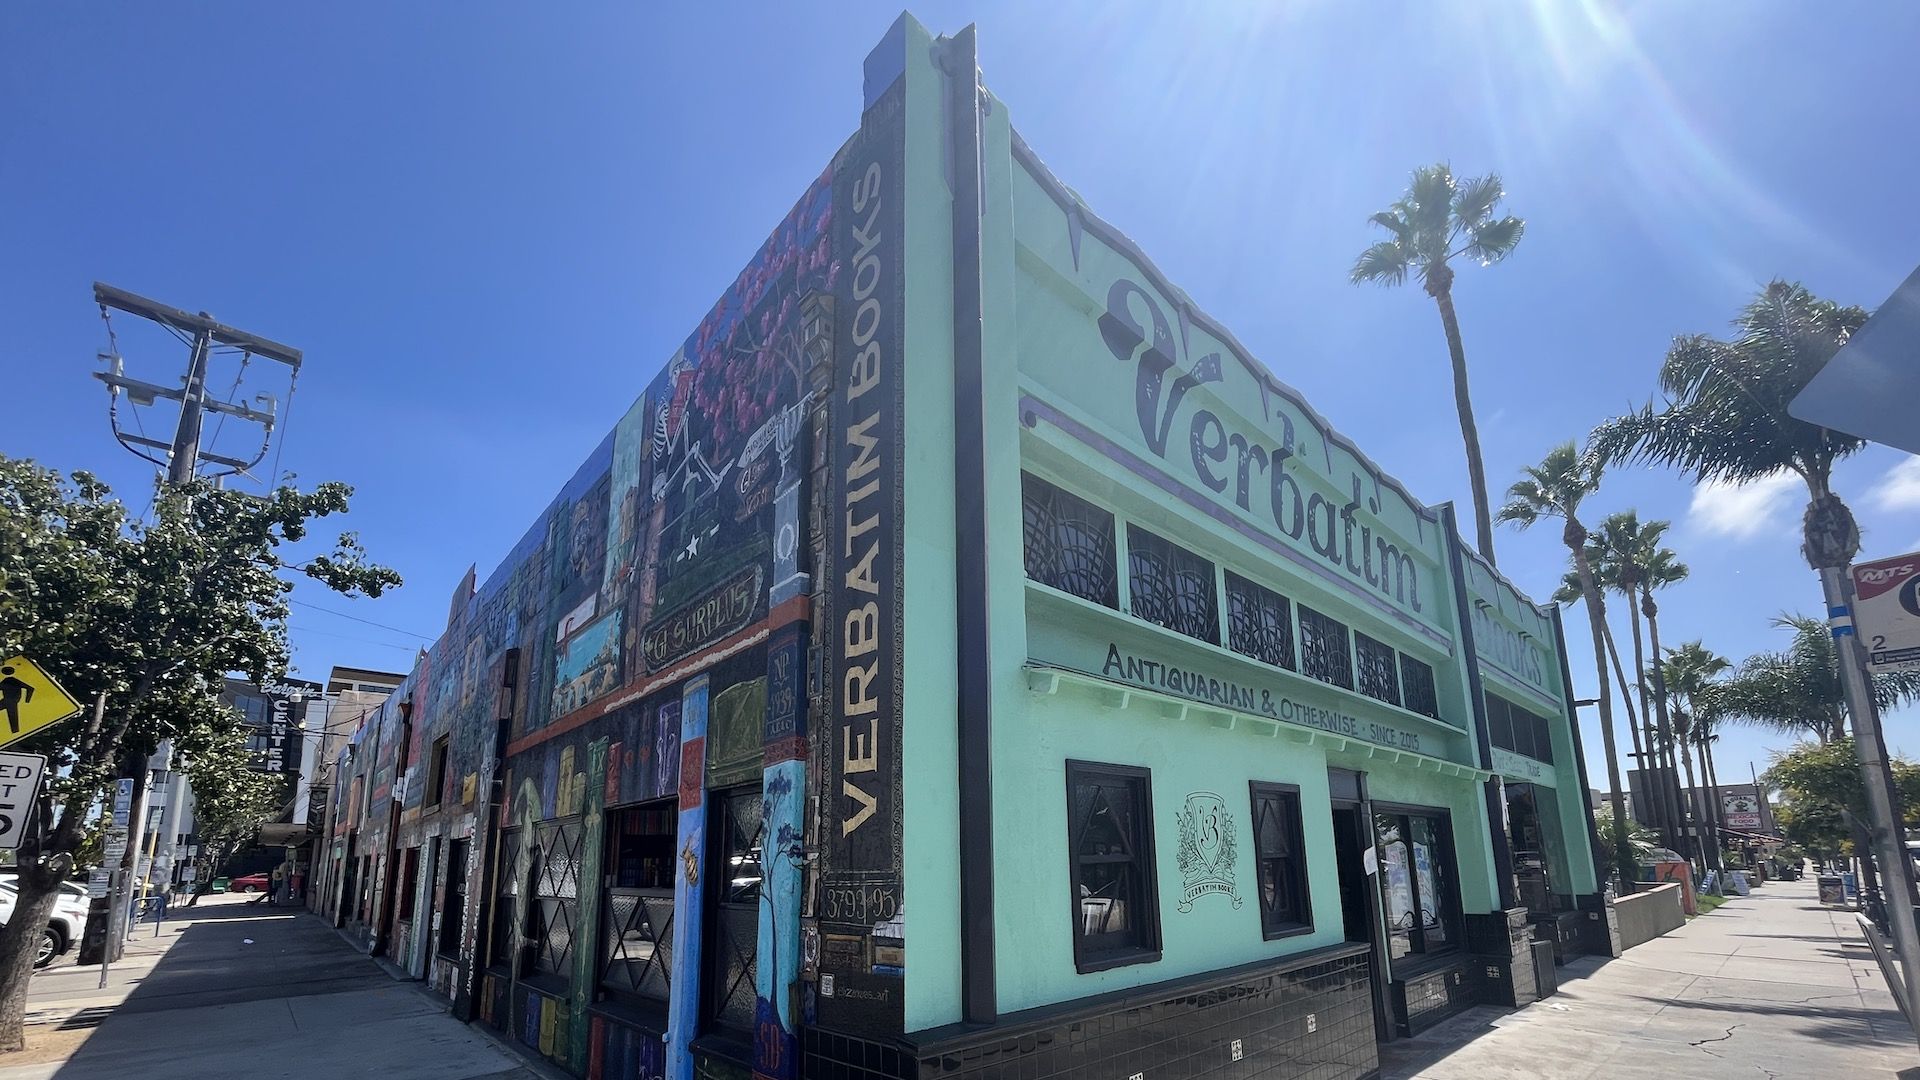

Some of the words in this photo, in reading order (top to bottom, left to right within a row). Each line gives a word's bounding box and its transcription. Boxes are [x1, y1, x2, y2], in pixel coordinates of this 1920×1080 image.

[848, 161, 881, 404] BOOKS
[1097, 279, 1422, 613] Verbatim
[674, 585, 749, 648] SURPLUS
[1860, 564, 1914, 582] MTS
[842, 410, 881, 838] VERBATIM
[1872, 635, 1887, 650] 2
[267, 700, 289, 770] CENTER
[1102, 643, 1255, 709] ANTIQUARIAN
[1261, 689, 1278, 717] &
[1281, 699, 1358, 736] OTHERWISE
[1370, 723, 1397, 746] SINCE
[1400, 730, 1420, 750] 2015
